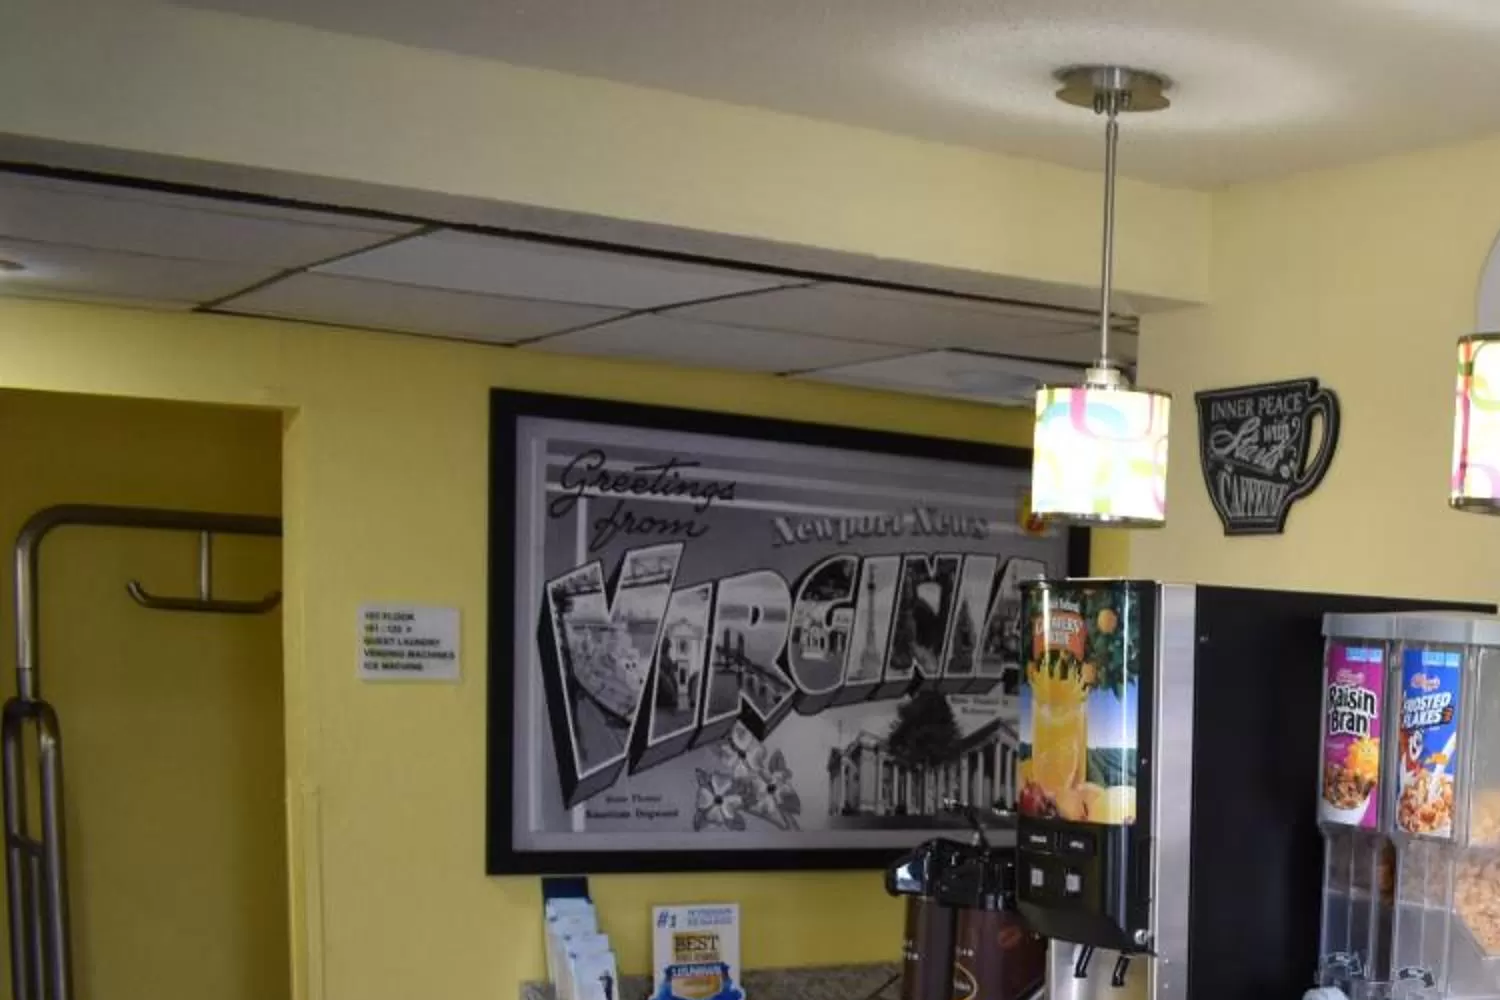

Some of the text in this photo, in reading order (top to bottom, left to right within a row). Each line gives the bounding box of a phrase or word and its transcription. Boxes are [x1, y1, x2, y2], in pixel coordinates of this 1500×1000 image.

[1211, 392, 1303, 421] INNER PEACE
[550, 449, 737, 518] Greetings
[589, 500, 710, 552] from
[770, 506, 990, 547] Newport News
[1329, 685, 1376, 716] Raisin
[1330, 710, 1368, 733] Bran
[657, 911, 677, 929] #1
[674, 935, 719, 952] BEST
